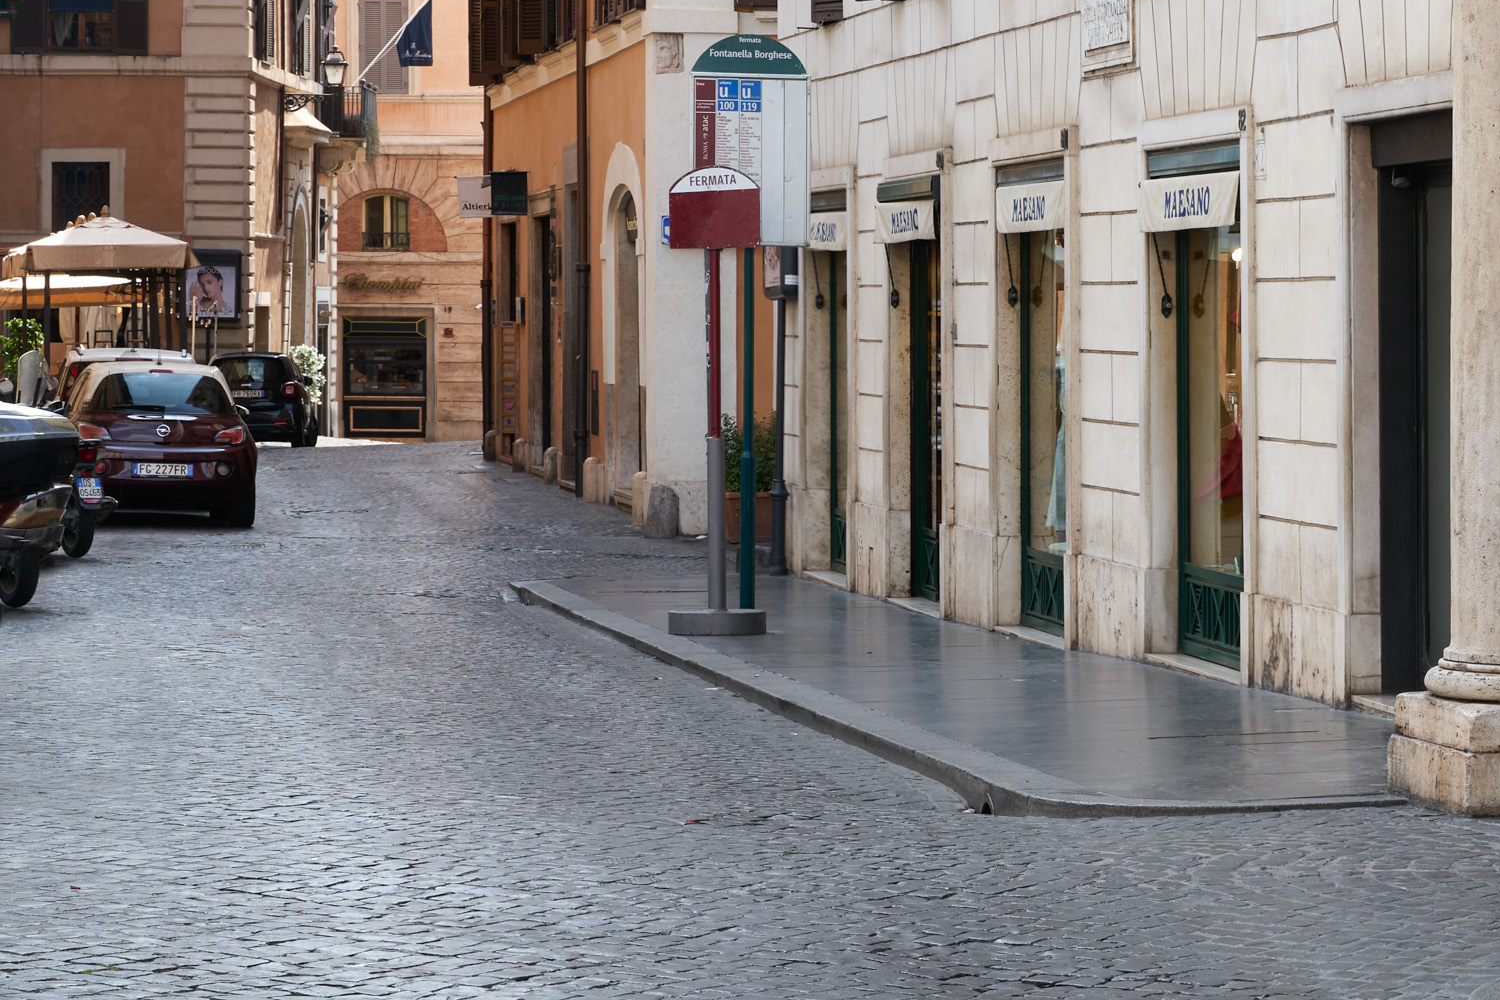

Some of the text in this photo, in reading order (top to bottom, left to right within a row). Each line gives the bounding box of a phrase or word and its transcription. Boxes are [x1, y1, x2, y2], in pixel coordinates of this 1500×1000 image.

[738, 36, 762, 44] fermata
[709, 48, 792, 61] Fontanella Borghese
[719, 102, 735, 111] 100
[742, 103, 757, 112] 119
[689, 174, 737, 187] FERMATA
[1164, 186, 1211, 219] MAESANO
[1011, 195, 1046, 223] MAESANO
[891, 208, 919, 235] MAESANO
[443, 306, 453, 314] 19
[139, 464, 188, 475] FG 227FR
